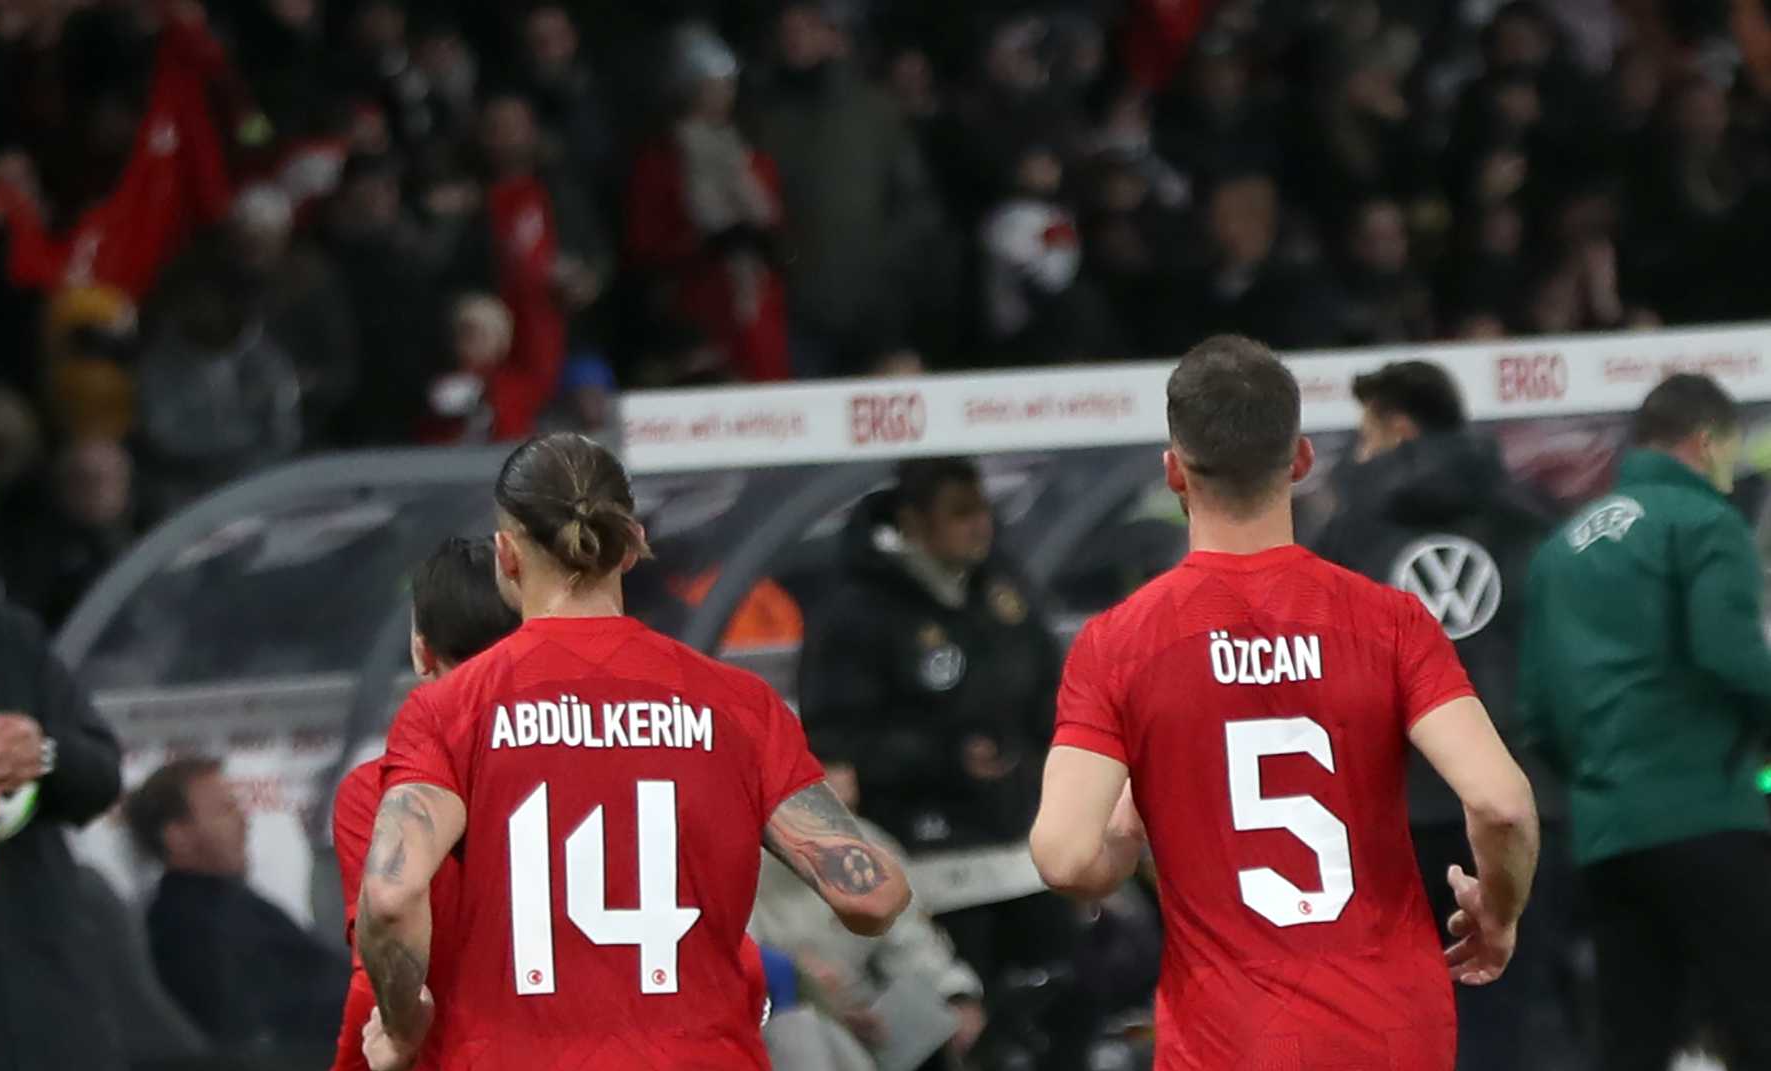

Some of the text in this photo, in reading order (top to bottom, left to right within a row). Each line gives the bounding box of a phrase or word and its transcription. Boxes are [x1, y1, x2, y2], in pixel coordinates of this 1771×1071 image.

[1497, 355, 1567, 401] ERGO
[849, 394, 925, 446] ERGO
[1210, 630, 1321, 685] ÖZCAN
[492, 694, 712, 751] ABDÜLKERİM
[1225, 716, 1355, 927] 5
[508, 780, 701, 995] 14
